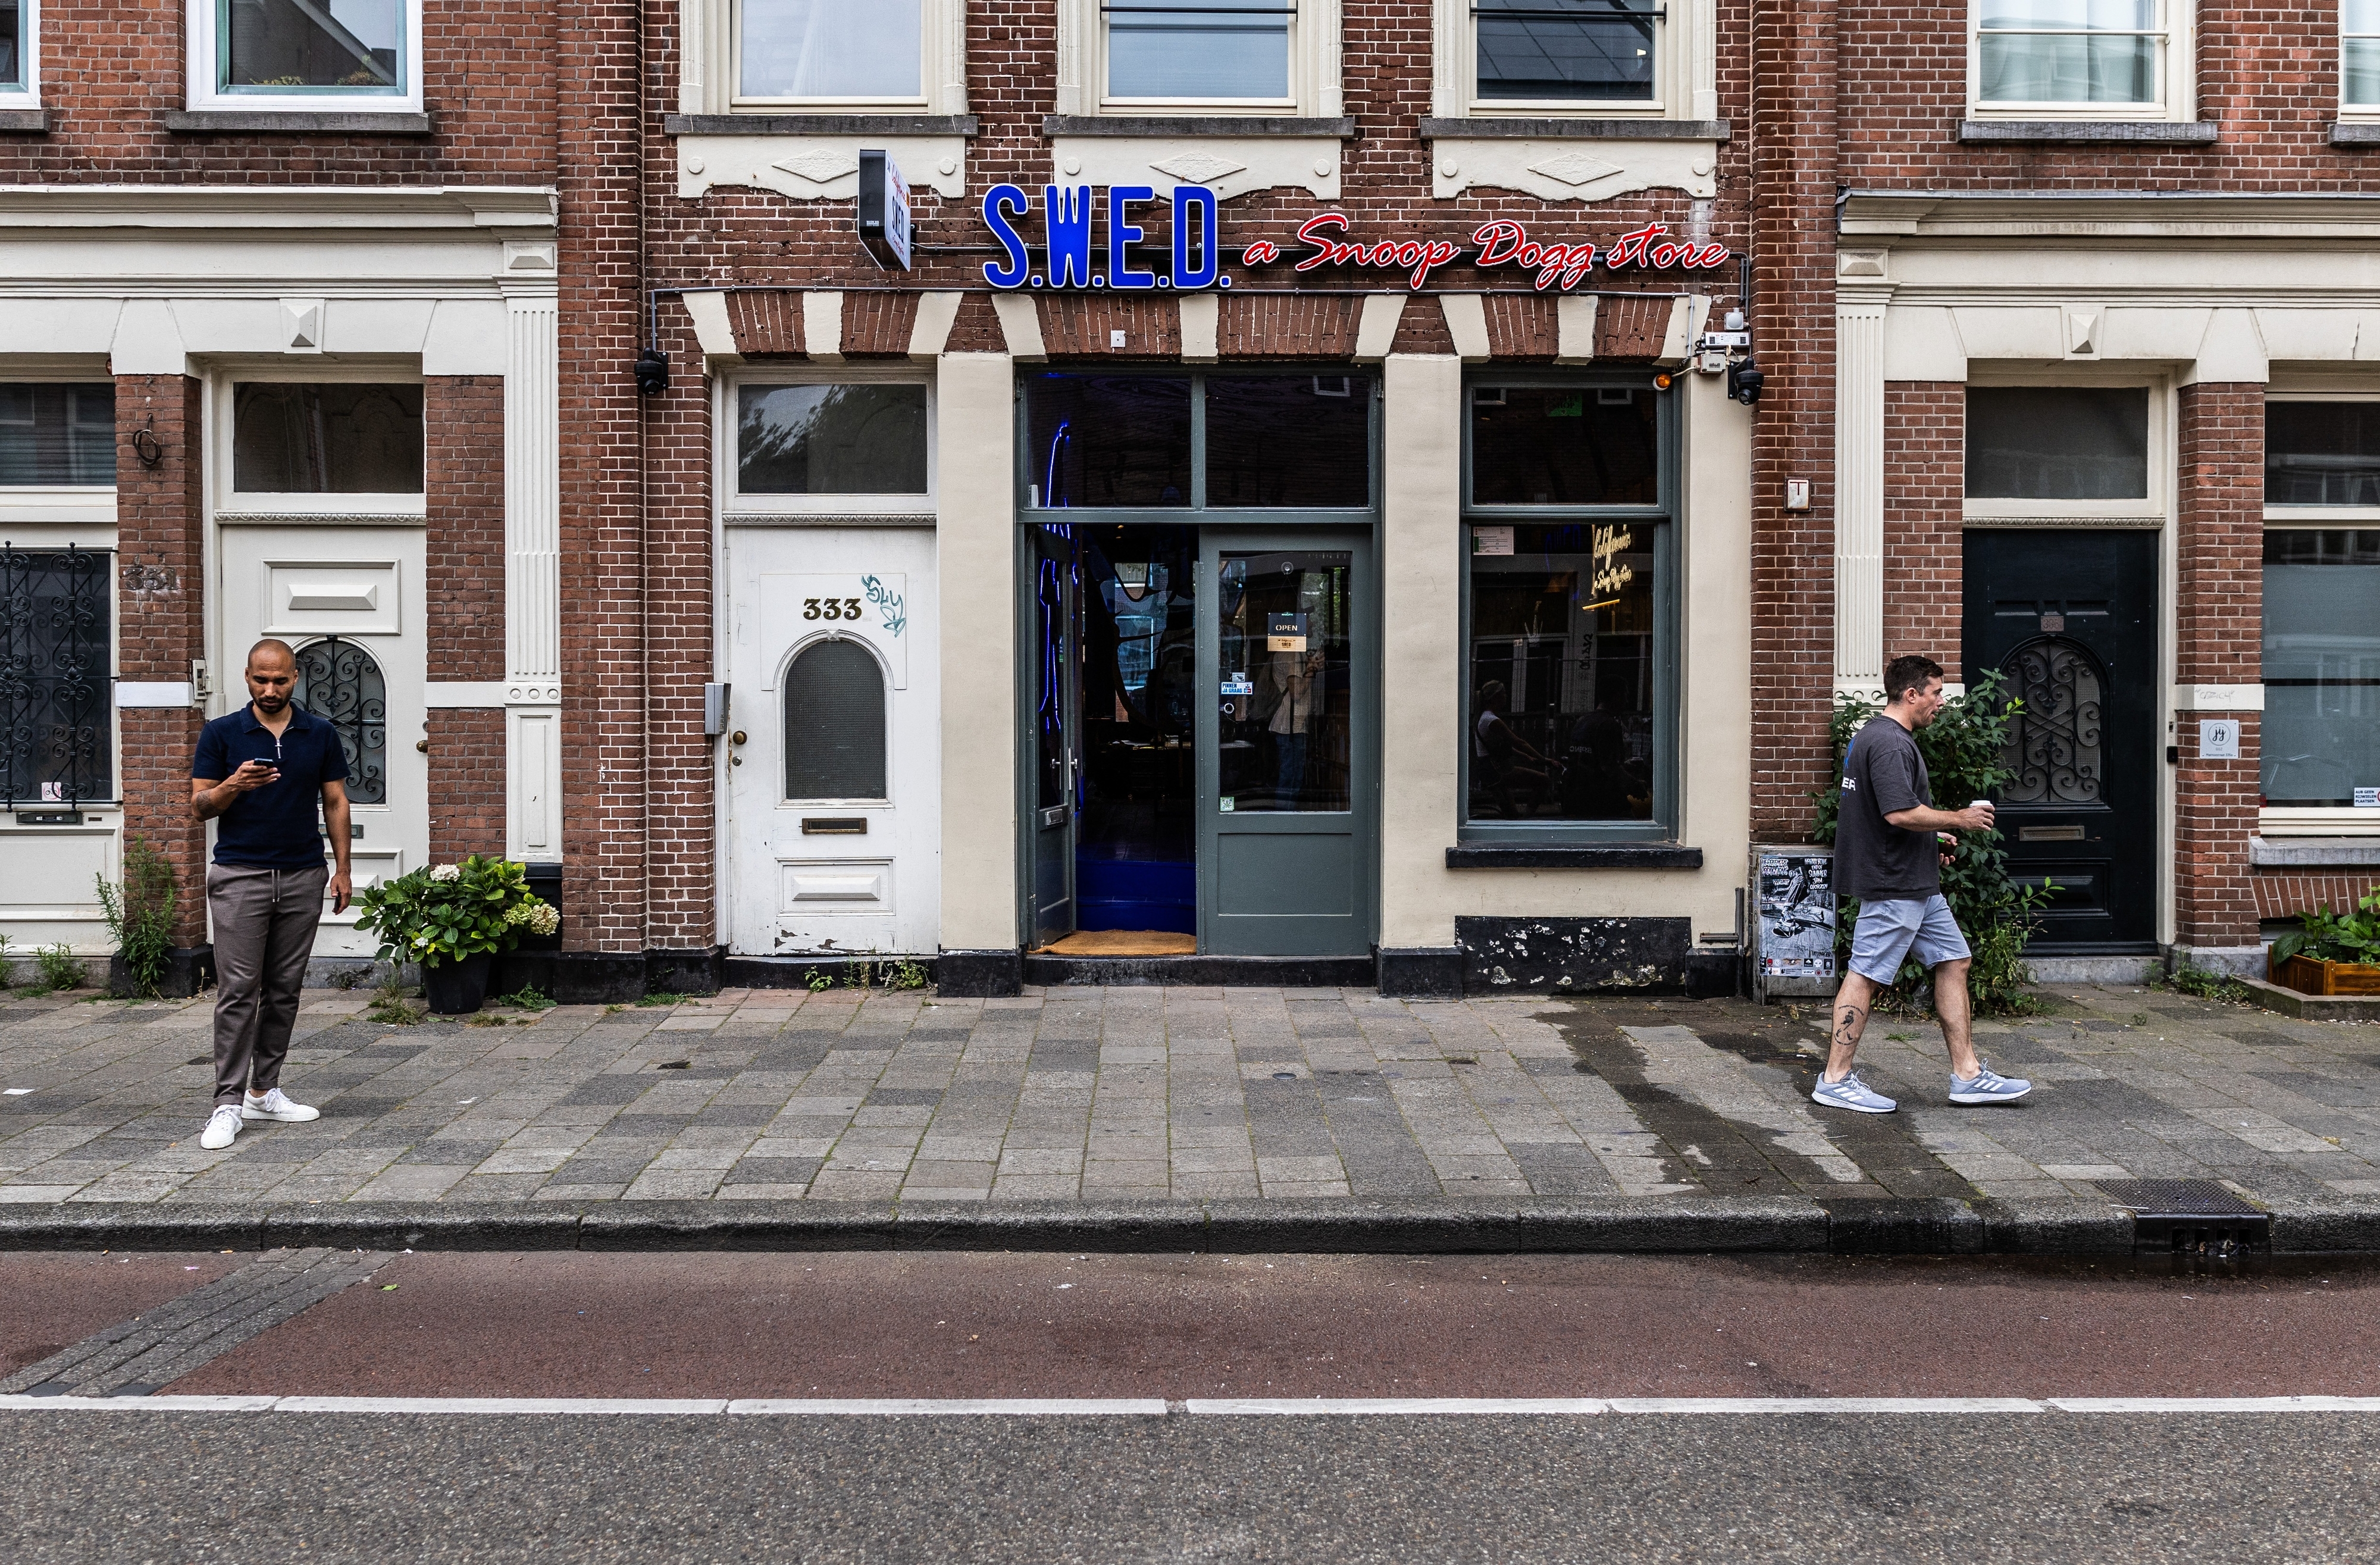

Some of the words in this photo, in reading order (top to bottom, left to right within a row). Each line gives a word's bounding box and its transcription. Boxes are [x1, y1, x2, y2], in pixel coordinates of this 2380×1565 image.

[892, 195, 904, 243] SWED
[982, 183, 1232, 289] S.W.E.D.
[1242, 240, 1279, 266] a
[1295, 212, 1461, 291] Snoop
[1471, 218, 1596, 292] Dogg
[1606, 221, 1730, 270] store
[123, 566, 178, 590] 331
[803, 597, 862, 621] 333
